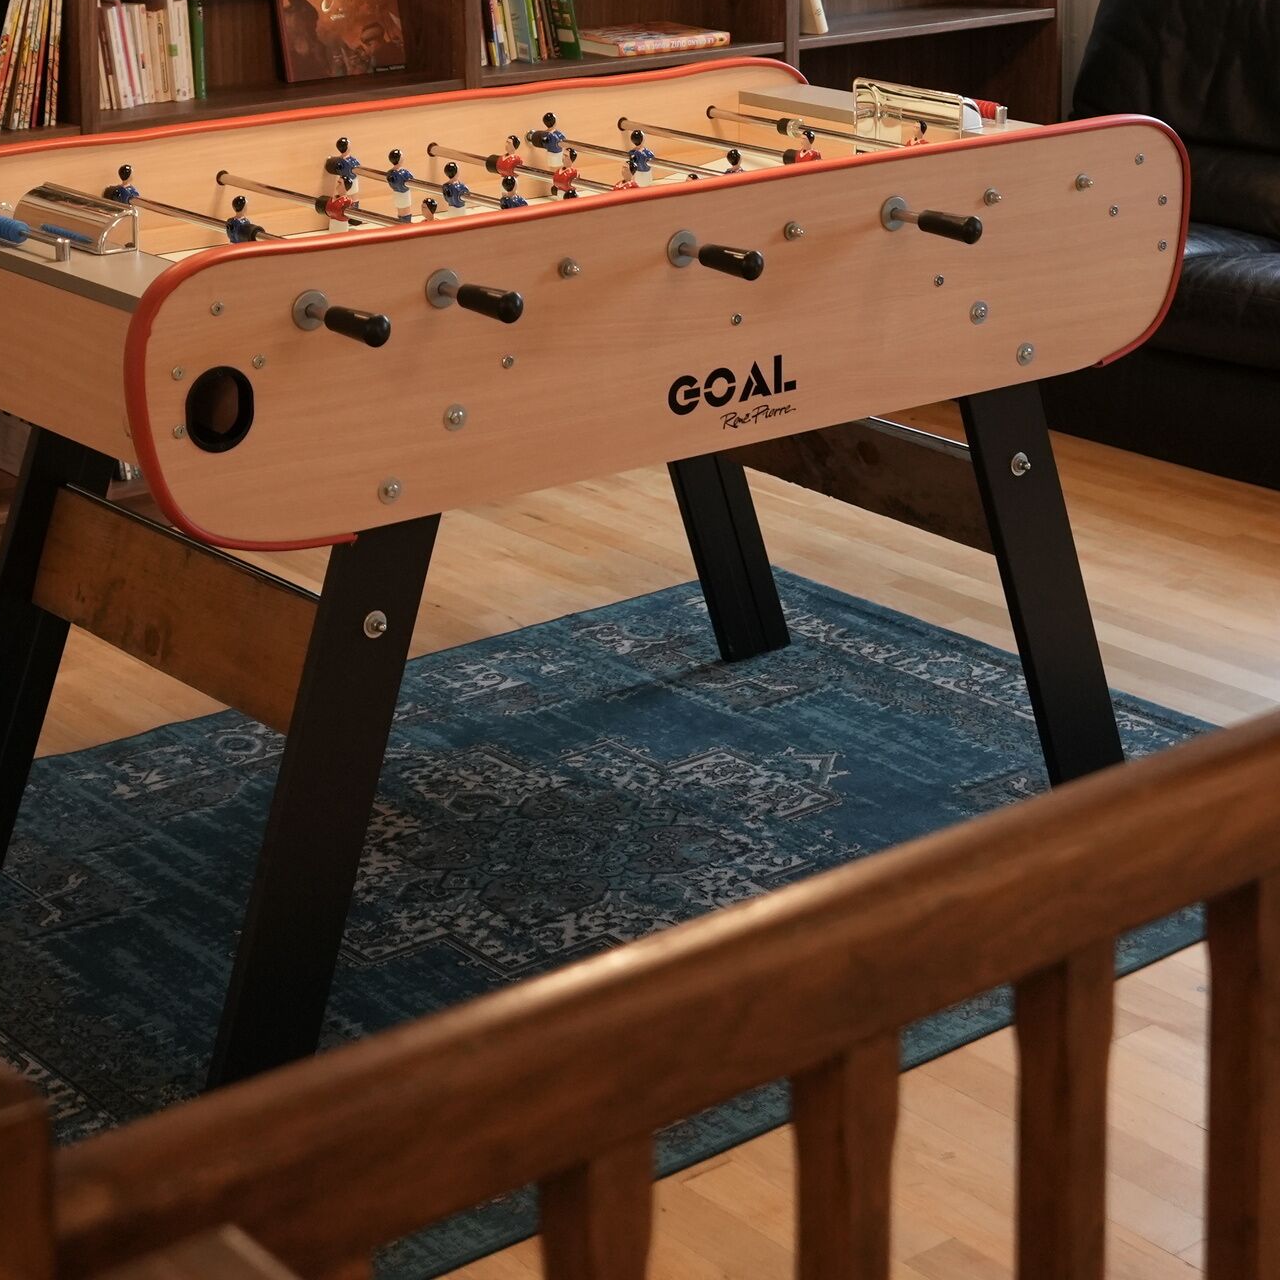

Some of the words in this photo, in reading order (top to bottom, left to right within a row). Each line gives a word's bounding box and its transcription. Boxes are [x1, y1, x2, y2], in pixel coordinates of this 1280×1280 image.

[670, 40, 687, 49] QUIZ
[668, 354, 797, 416] GOAL
[720, 411, 751, 430] René
[751, 404, 797, 424] Pierre
